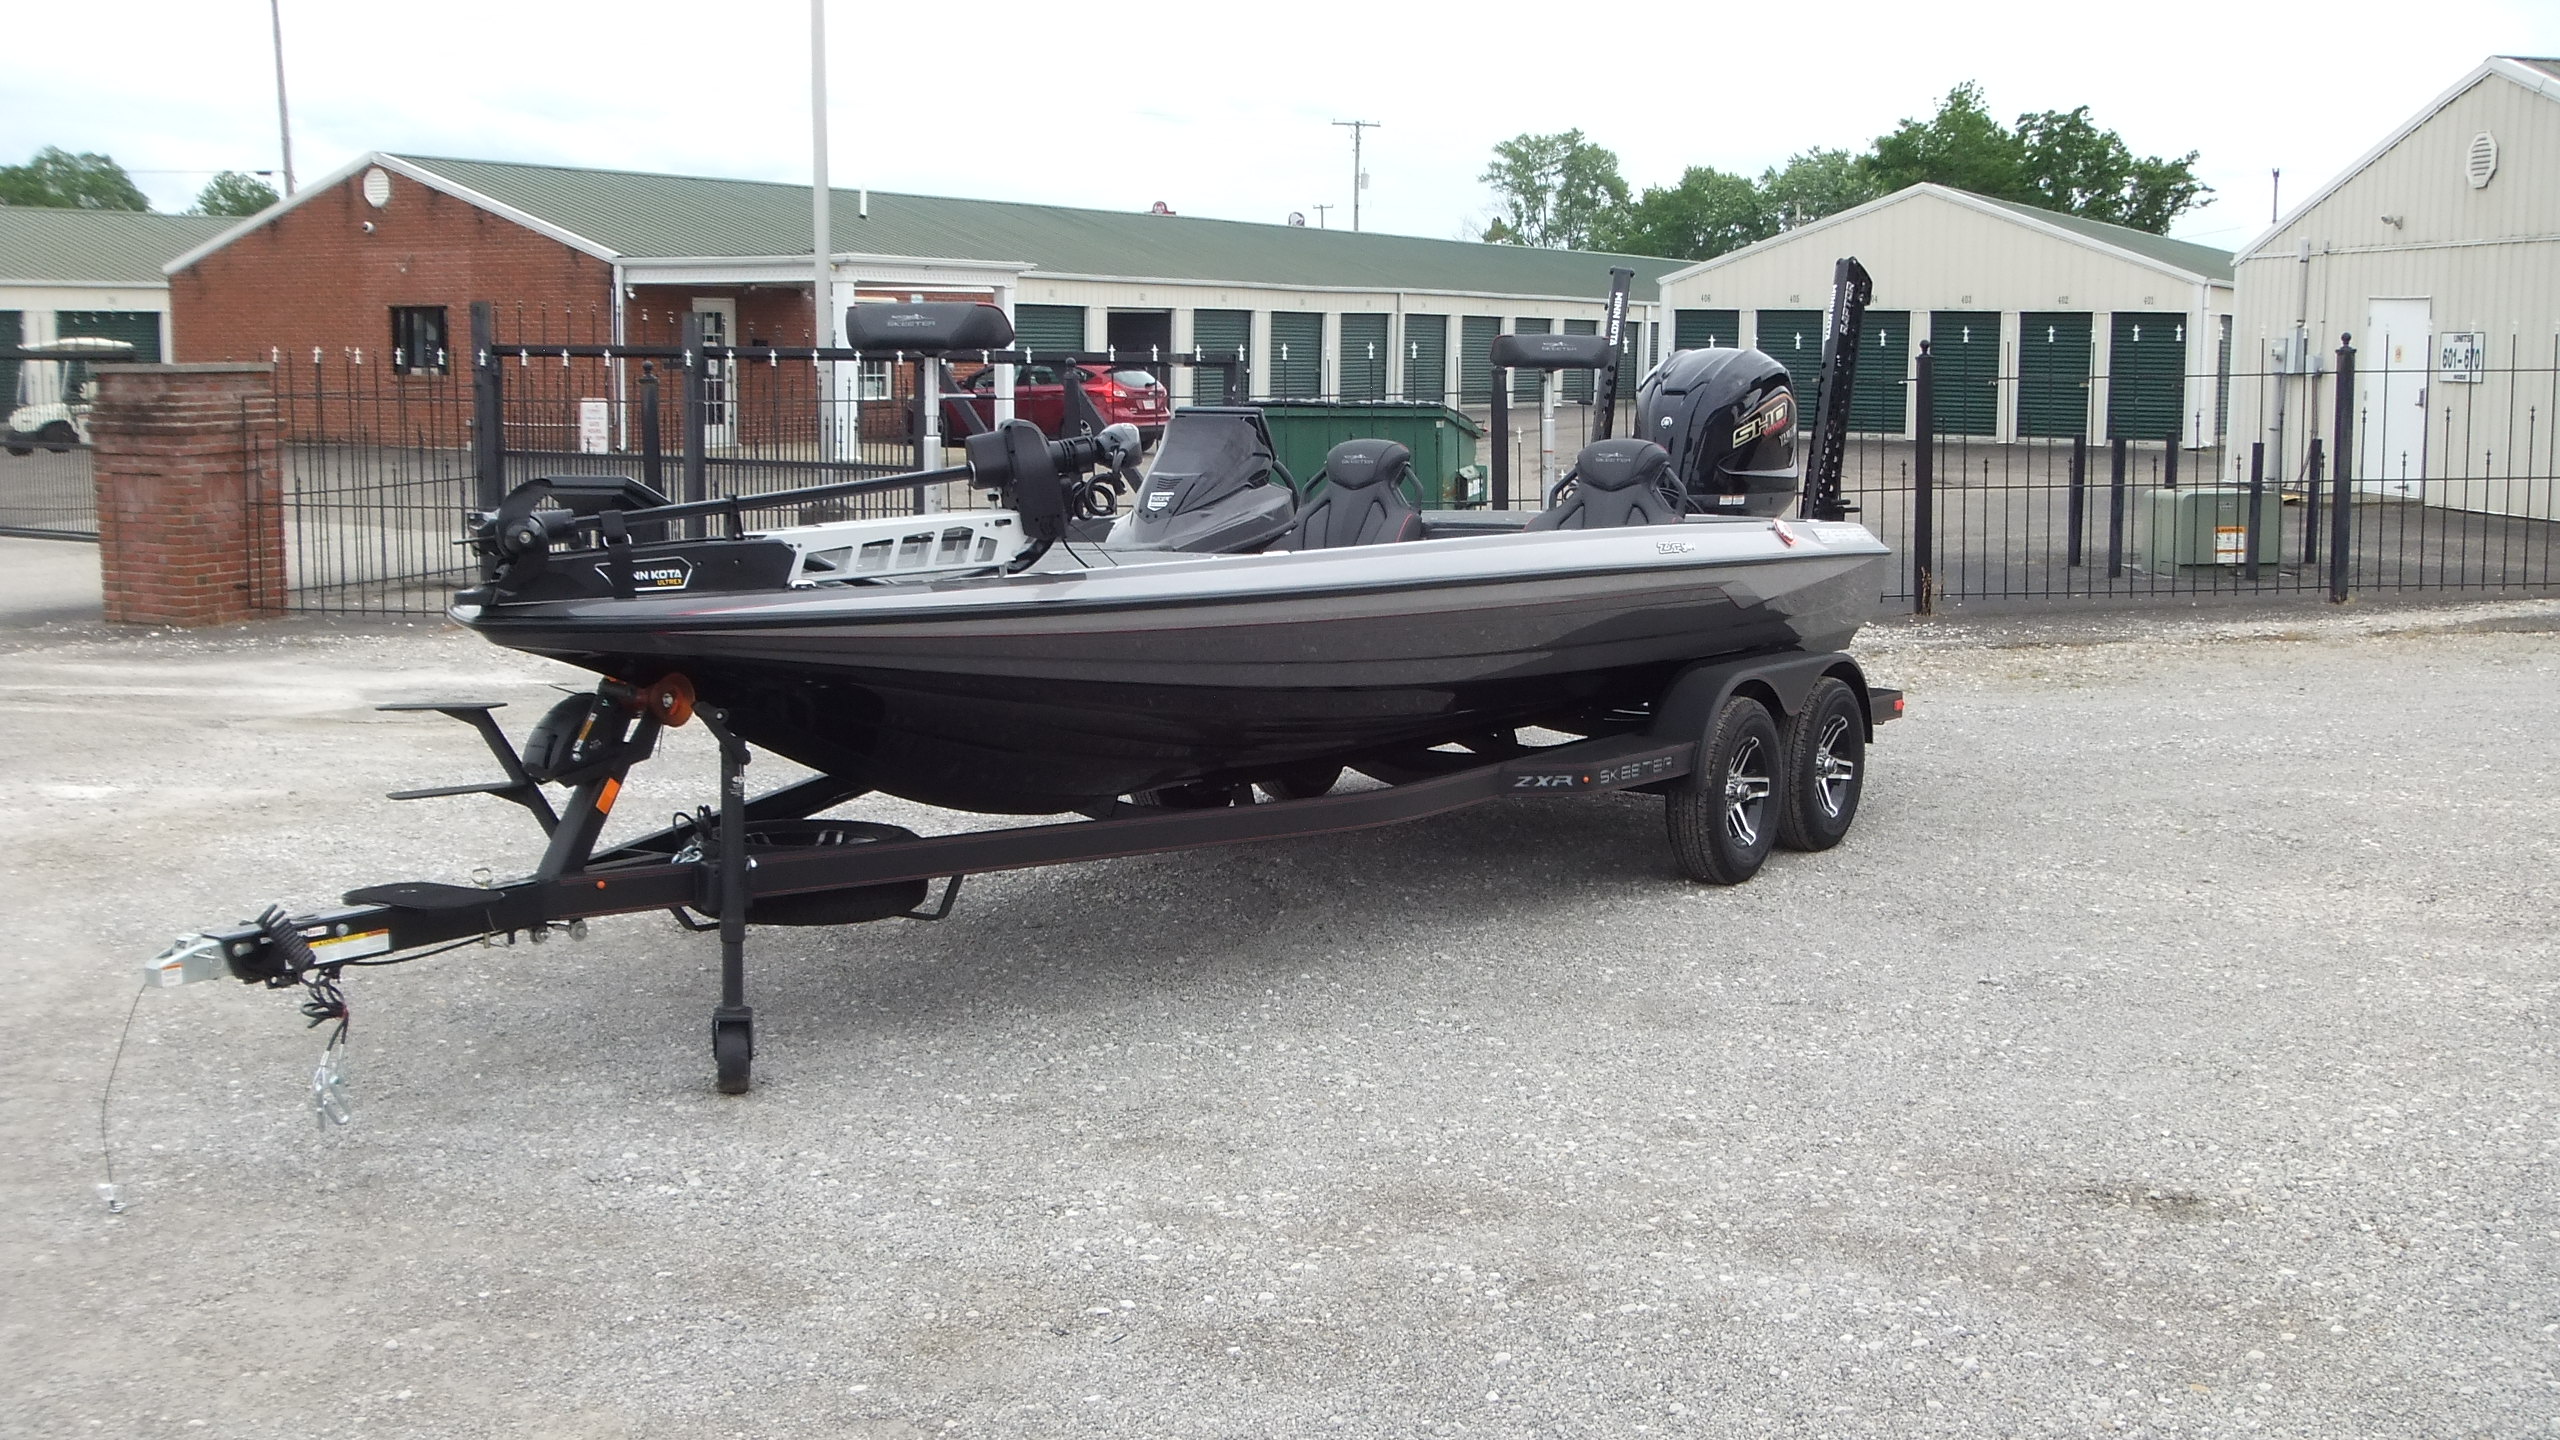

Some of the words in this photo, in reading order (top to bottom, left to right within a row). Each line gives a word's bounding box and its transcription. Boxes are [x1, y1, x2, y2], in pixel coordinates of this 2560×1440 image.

[1612, 291, 1624, 319] MINN
[1609, 319, 1620, 346] KOTA
[2453, 335, 2474, 343] UNITS
[1732, 402, 1788, 449] SHO
[633, 570, 649, 581] NN
[650, 569, 683, 580] KOTA
[656, 578, 683, 586] ULTREX
[1514, 775, 1574, 788] ZXR
[1600, 756, 1673, 785] SKEETER
